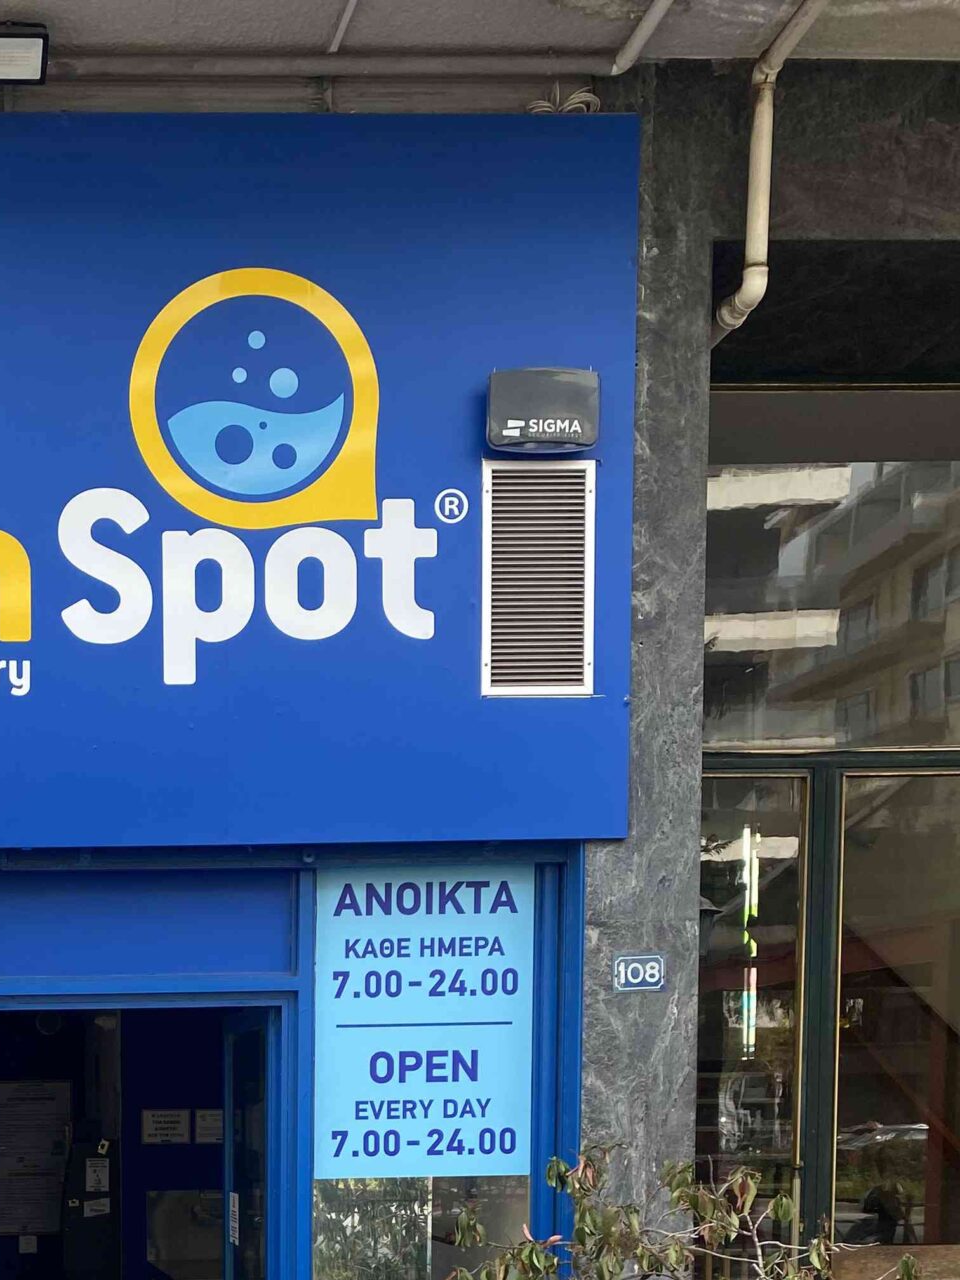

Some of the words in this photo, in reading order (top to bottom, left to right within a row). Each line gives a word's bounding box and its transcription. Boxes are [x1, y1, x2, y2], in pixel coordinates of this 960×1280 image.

[528, 418, 582, 433] SIGMA
[333, 880, 519, 917] ΑΝΟΙΚΤΑ
[344, 938, 411, 959] ΚΑΘΕ
[419, 936, 506, 958] ΗΜΕΡΑ
[616, 962, 660, 984] 108
[369, 1049, 479, 1084] OPEN
[354, 1099, 435, 1120] EVERY
[442, 1098, 491, 1119] DAY
